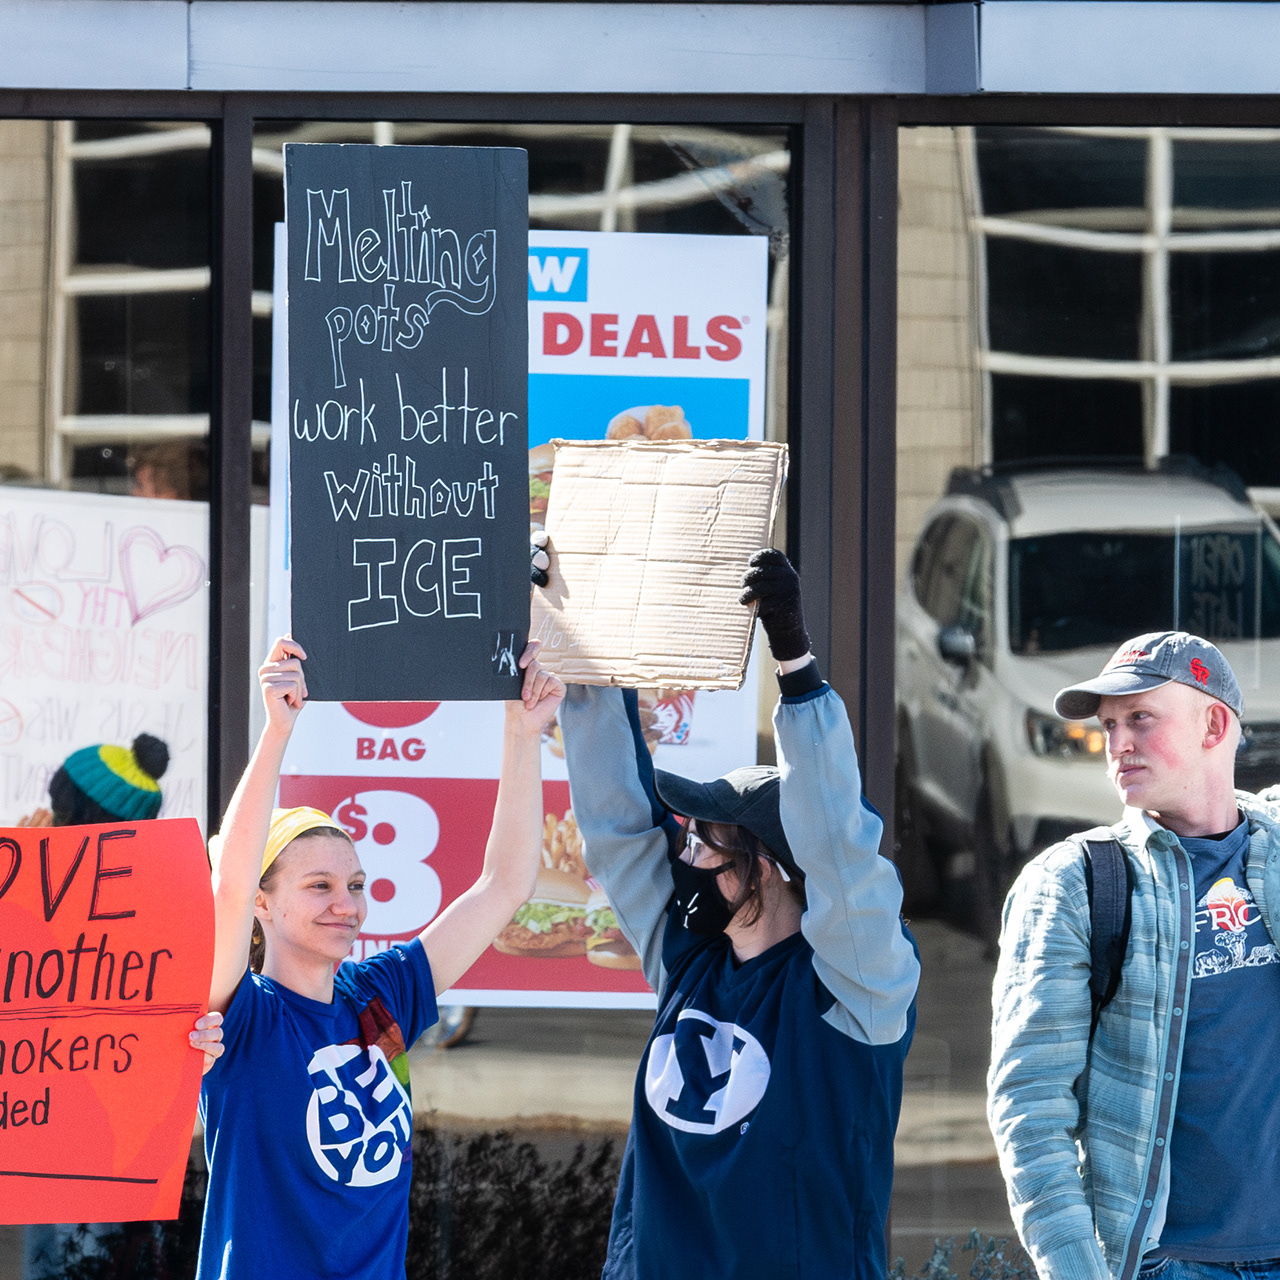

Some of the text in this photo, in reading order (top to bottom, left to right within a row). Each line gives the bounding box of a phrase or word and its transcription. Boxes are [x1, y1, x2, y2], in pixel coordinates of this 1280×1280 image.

[305, 181, 496, 316] Melting
[325, 283, 430, 389] pots
[293, 367, 518, 446] work better
[323, 453, 499, 522] without
[348, 537, 482, 632] ICE
[356, 737, 427, 762] BAG
[664, 1017, 747, 1126] Y
